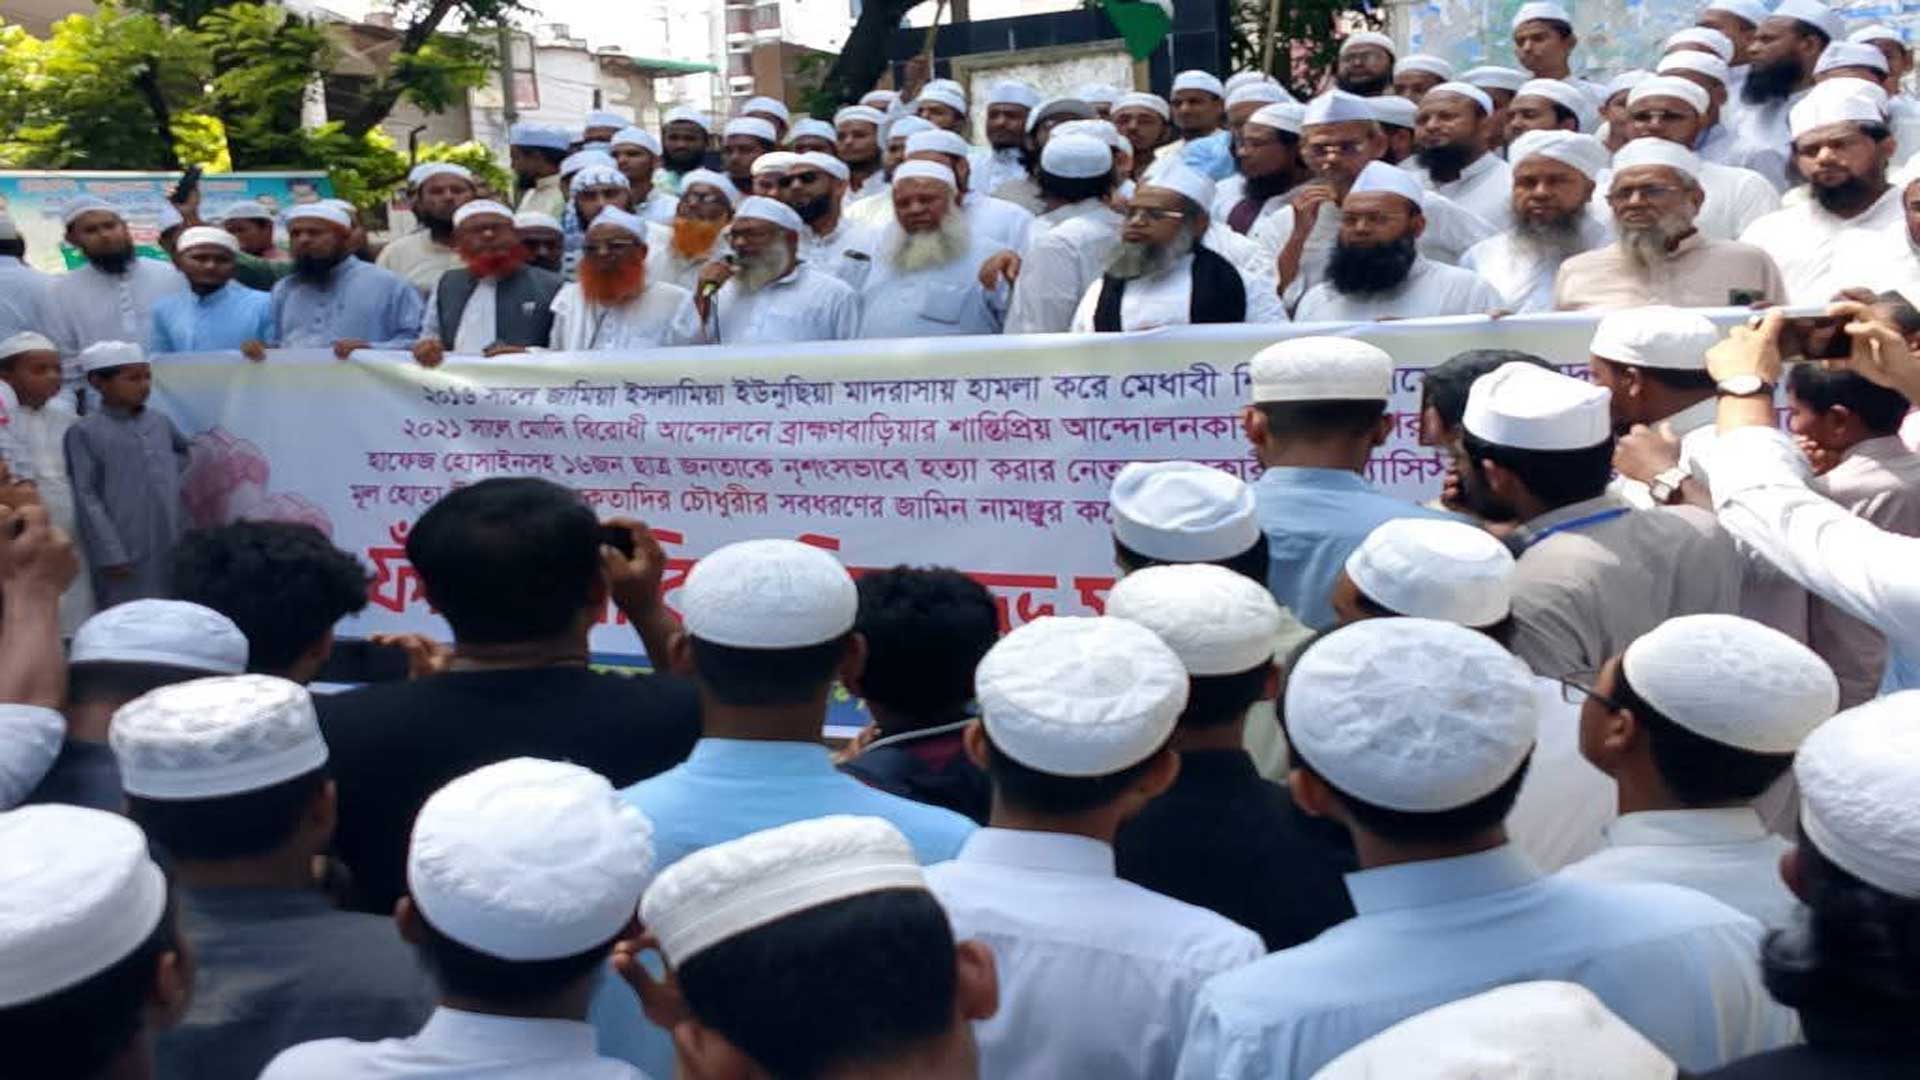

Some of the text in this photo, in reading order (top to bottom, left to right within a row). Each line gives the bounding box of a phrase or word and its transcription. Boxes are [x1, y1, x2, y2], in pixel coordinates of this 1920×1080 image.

[547, 380, 616, 406] জামিয়া
[624, 377, 724, 406] ইসলামিয়া
[843, 379, 957, 404] মাদরাসায়
[965, 376, 1042, 401] হামলা
[1052, 374, 1110, 399] করে
[1121, 362, 1221, 398] মেধাবী
[403, 418, 461, 439] ২০২১
[573, 413, 649, 441] বিরোধী
[657, 420, 773, 443] আন্দোলনে
[778, 411, 939, 447] ব্রাহ্মণবাড়িয়ার
[366, 452, 437, 471] হাফেজ
[444, 449, 555, 473] হোসাইনসহ
[677, 457, 773, 478] জনতাকে
[780, 457, 909, 485] নৃশংসভাবে
[915, 458, 978, 481] হত্যা
[986, 458, 1056, 482] করার
[681, 482, 769, 518] চৌধুরীর
[894, 489, 969, 522] জামিন
